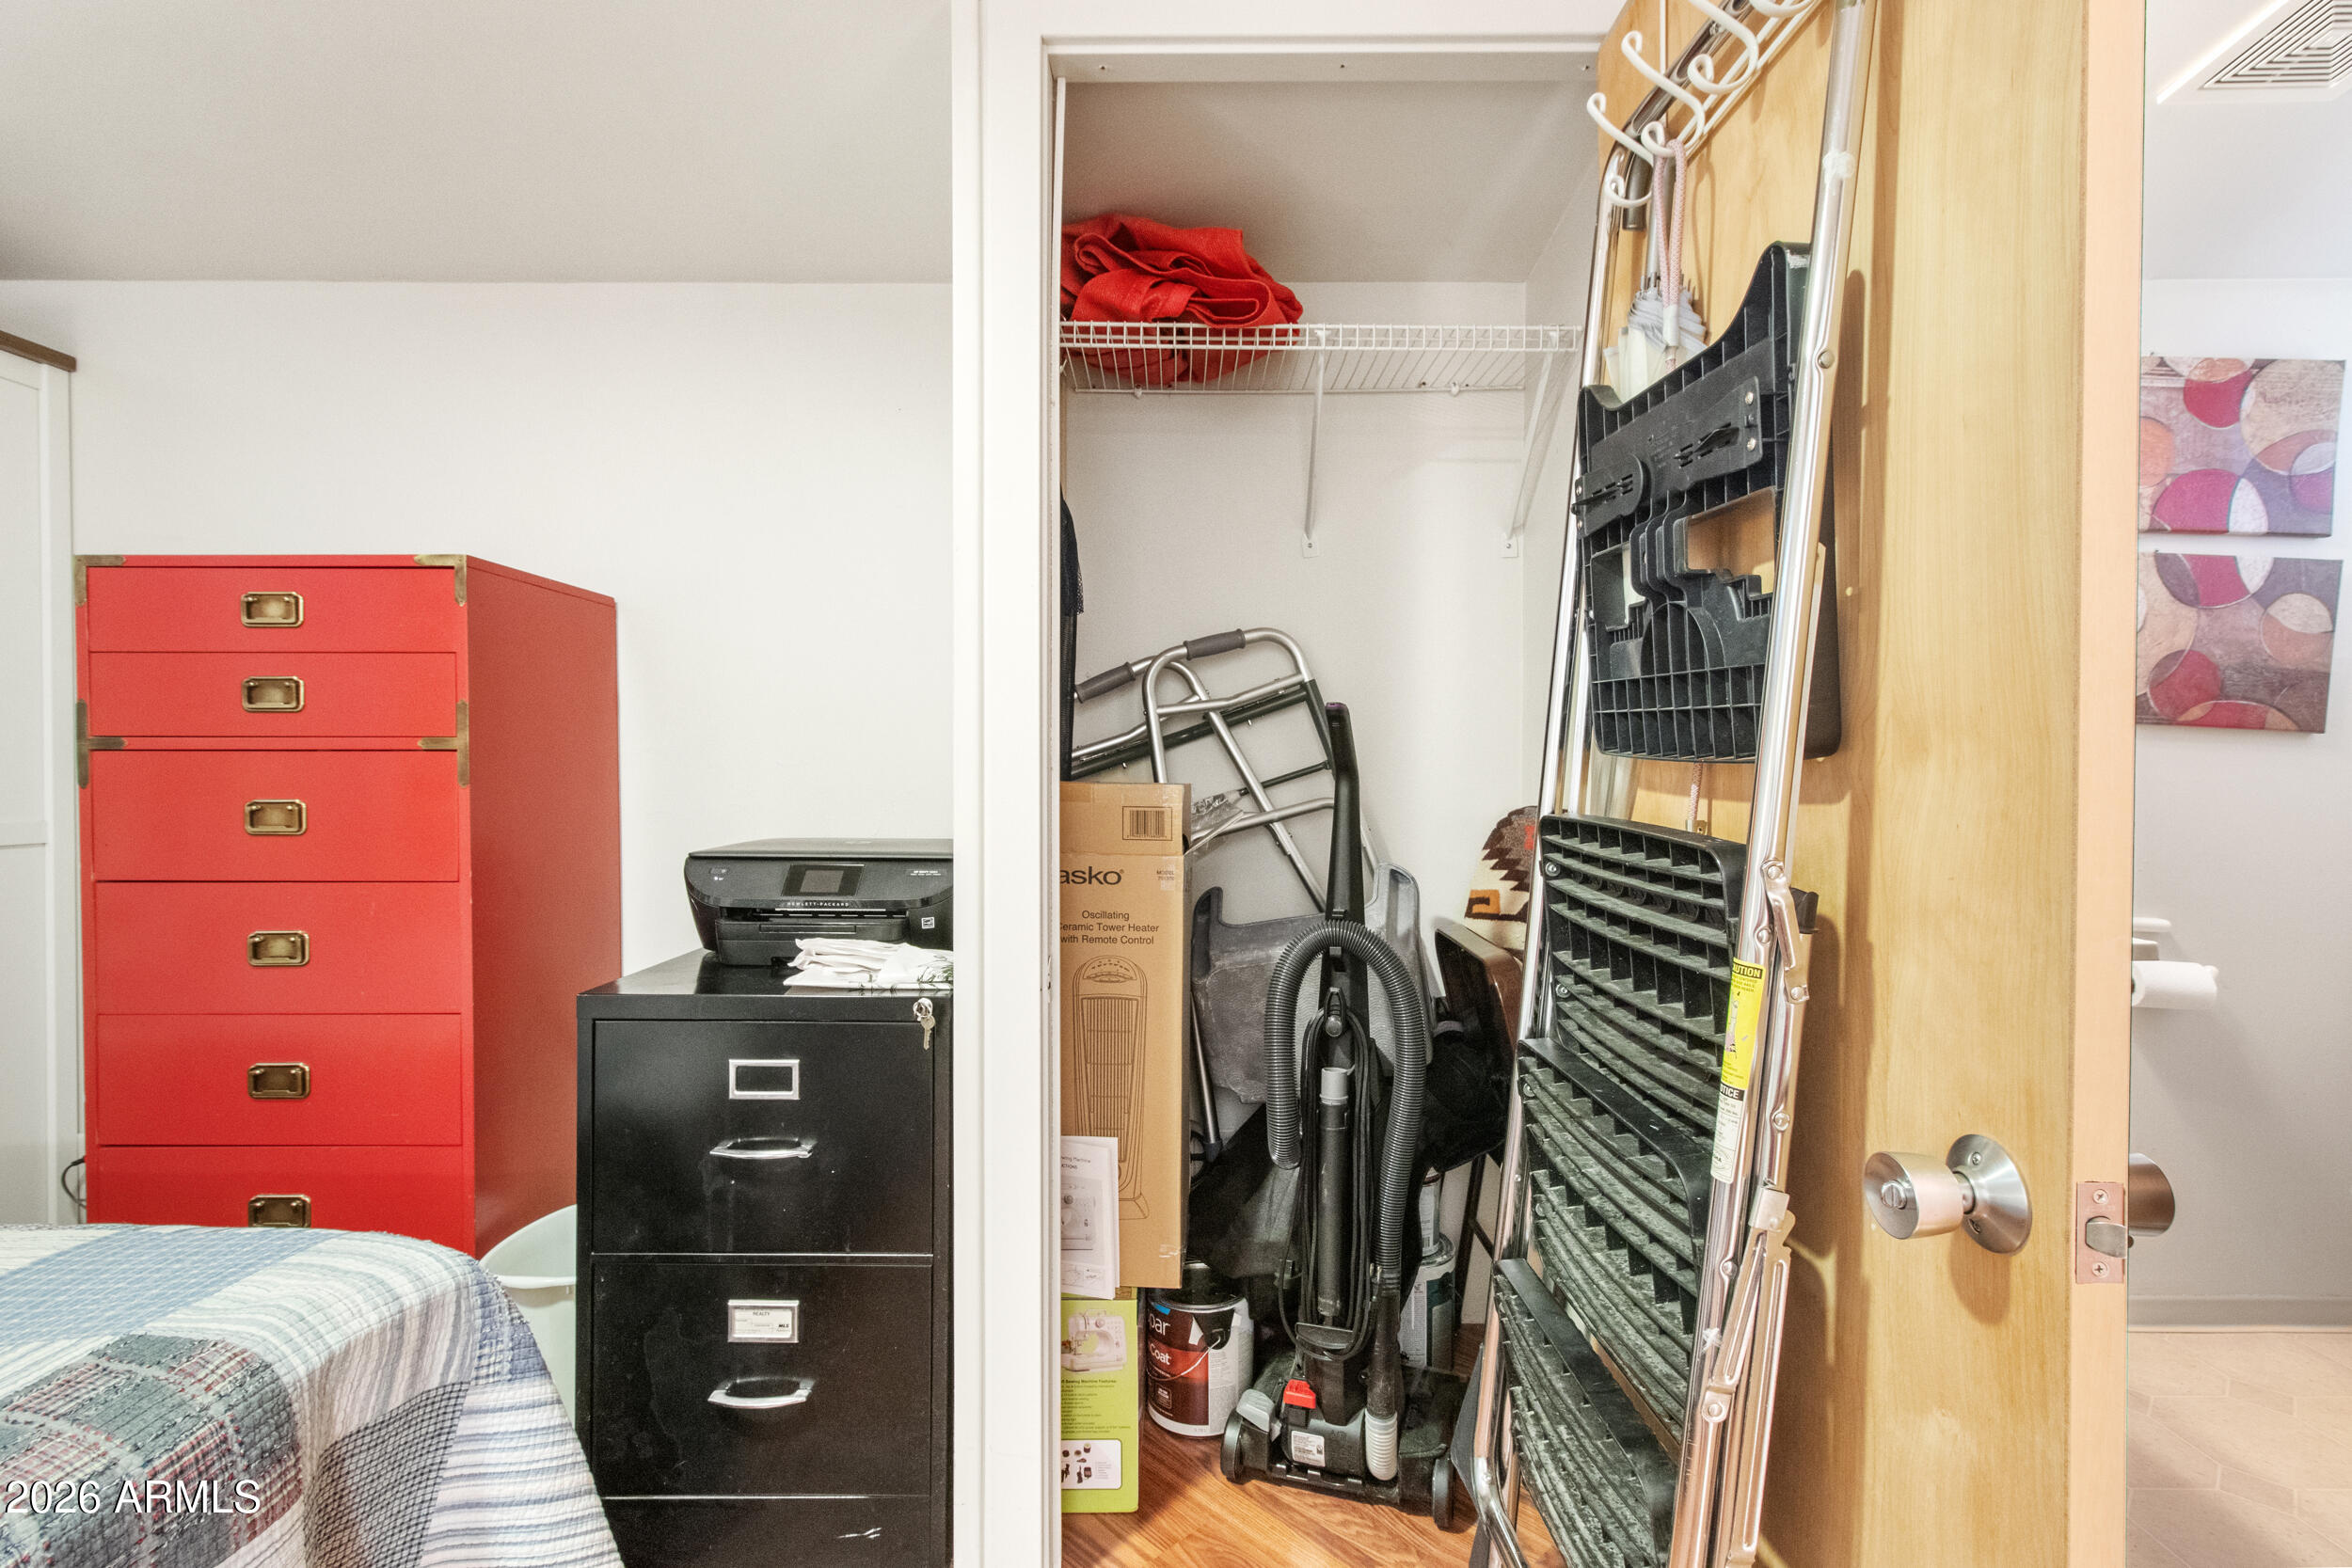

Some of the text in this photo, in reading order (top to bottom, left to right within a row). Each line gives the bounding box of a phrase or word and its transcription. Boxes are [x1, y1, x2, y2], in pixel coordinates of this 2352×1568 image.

[1081, 910, 1130, 922] Oscillating
[1096, 923, 1125, 931] Tower
[1128, 923, 1160, 932] Heater
[1060, 935, 1154, 944] with Remote Control
[1150, 1343, 1170, 1365] Coat
